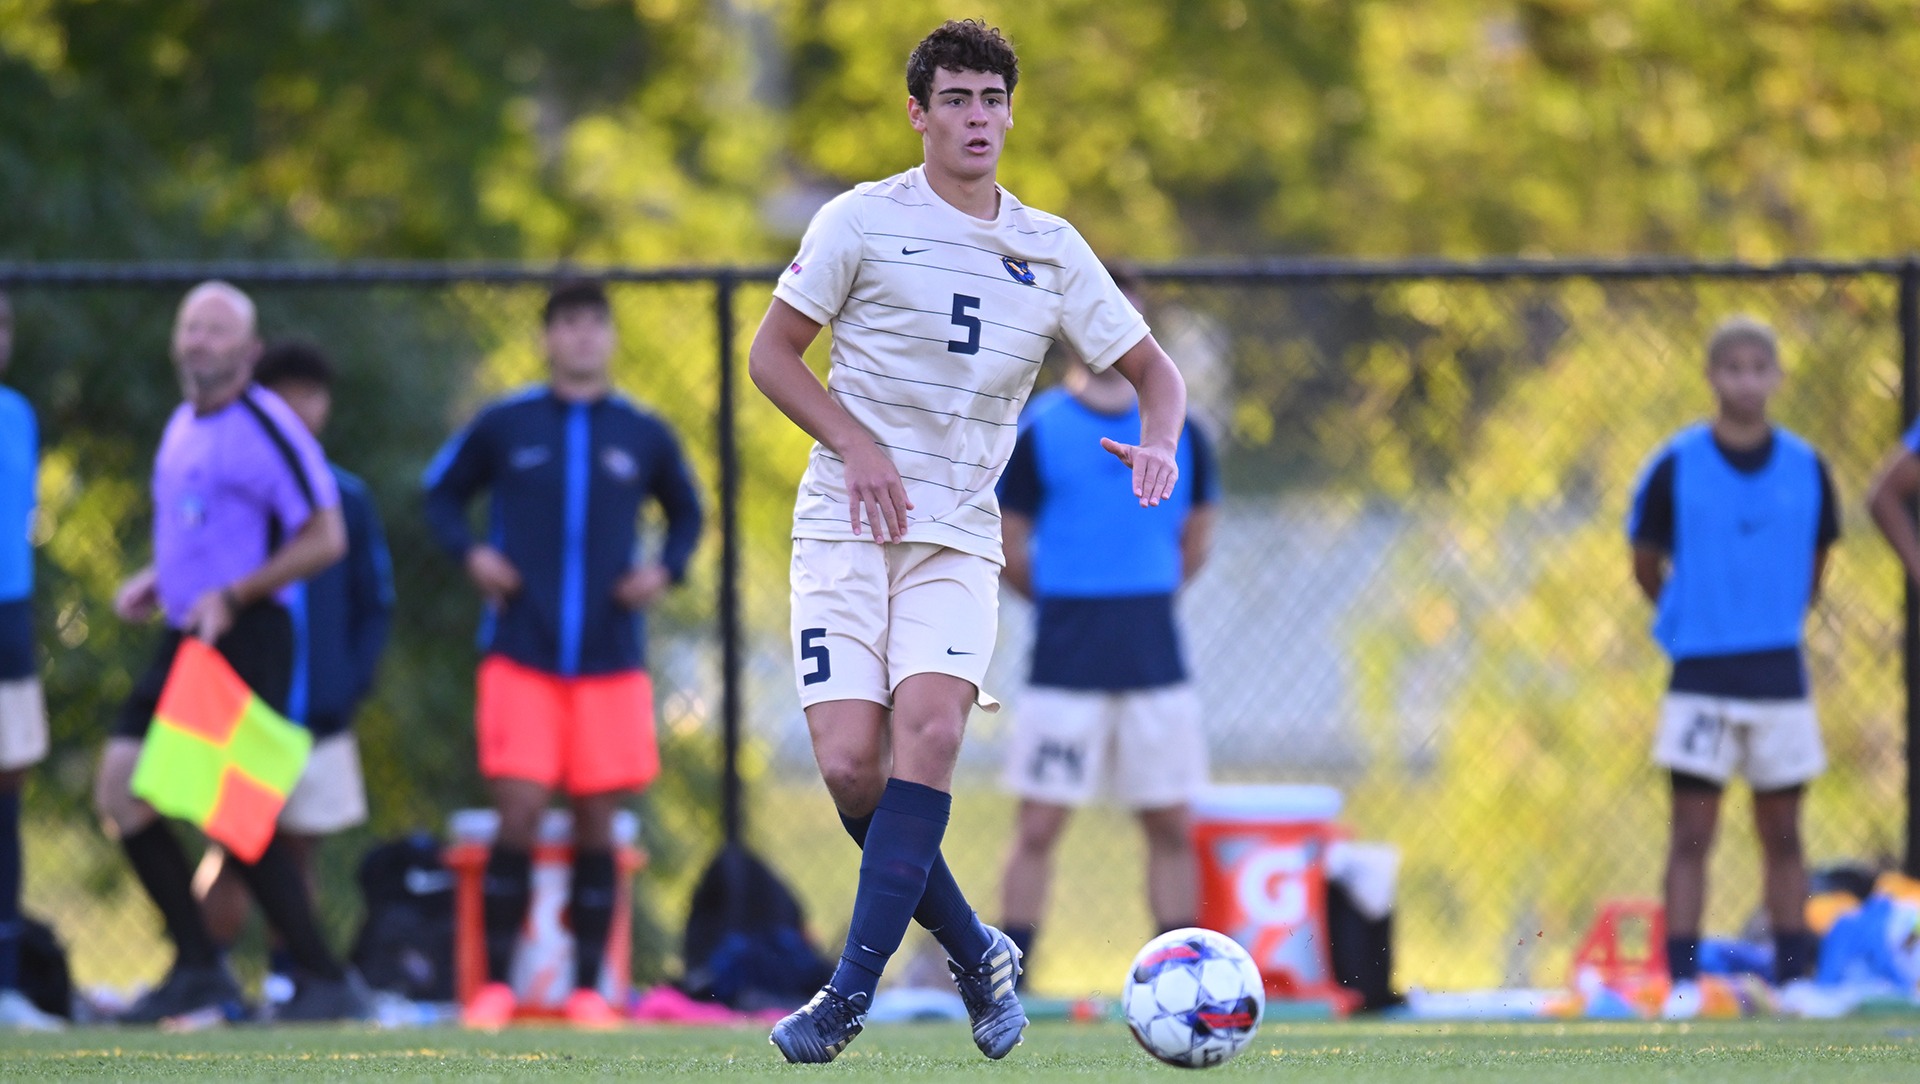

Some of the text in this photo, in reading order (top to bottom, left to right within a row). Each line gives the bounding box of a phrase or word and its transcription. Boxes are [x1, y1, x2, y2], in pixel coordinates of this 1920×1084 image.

[948, 293, 981, 355] 5
[801, 628, 831, 686] 5
[1239, 848, 1307, 925] G
